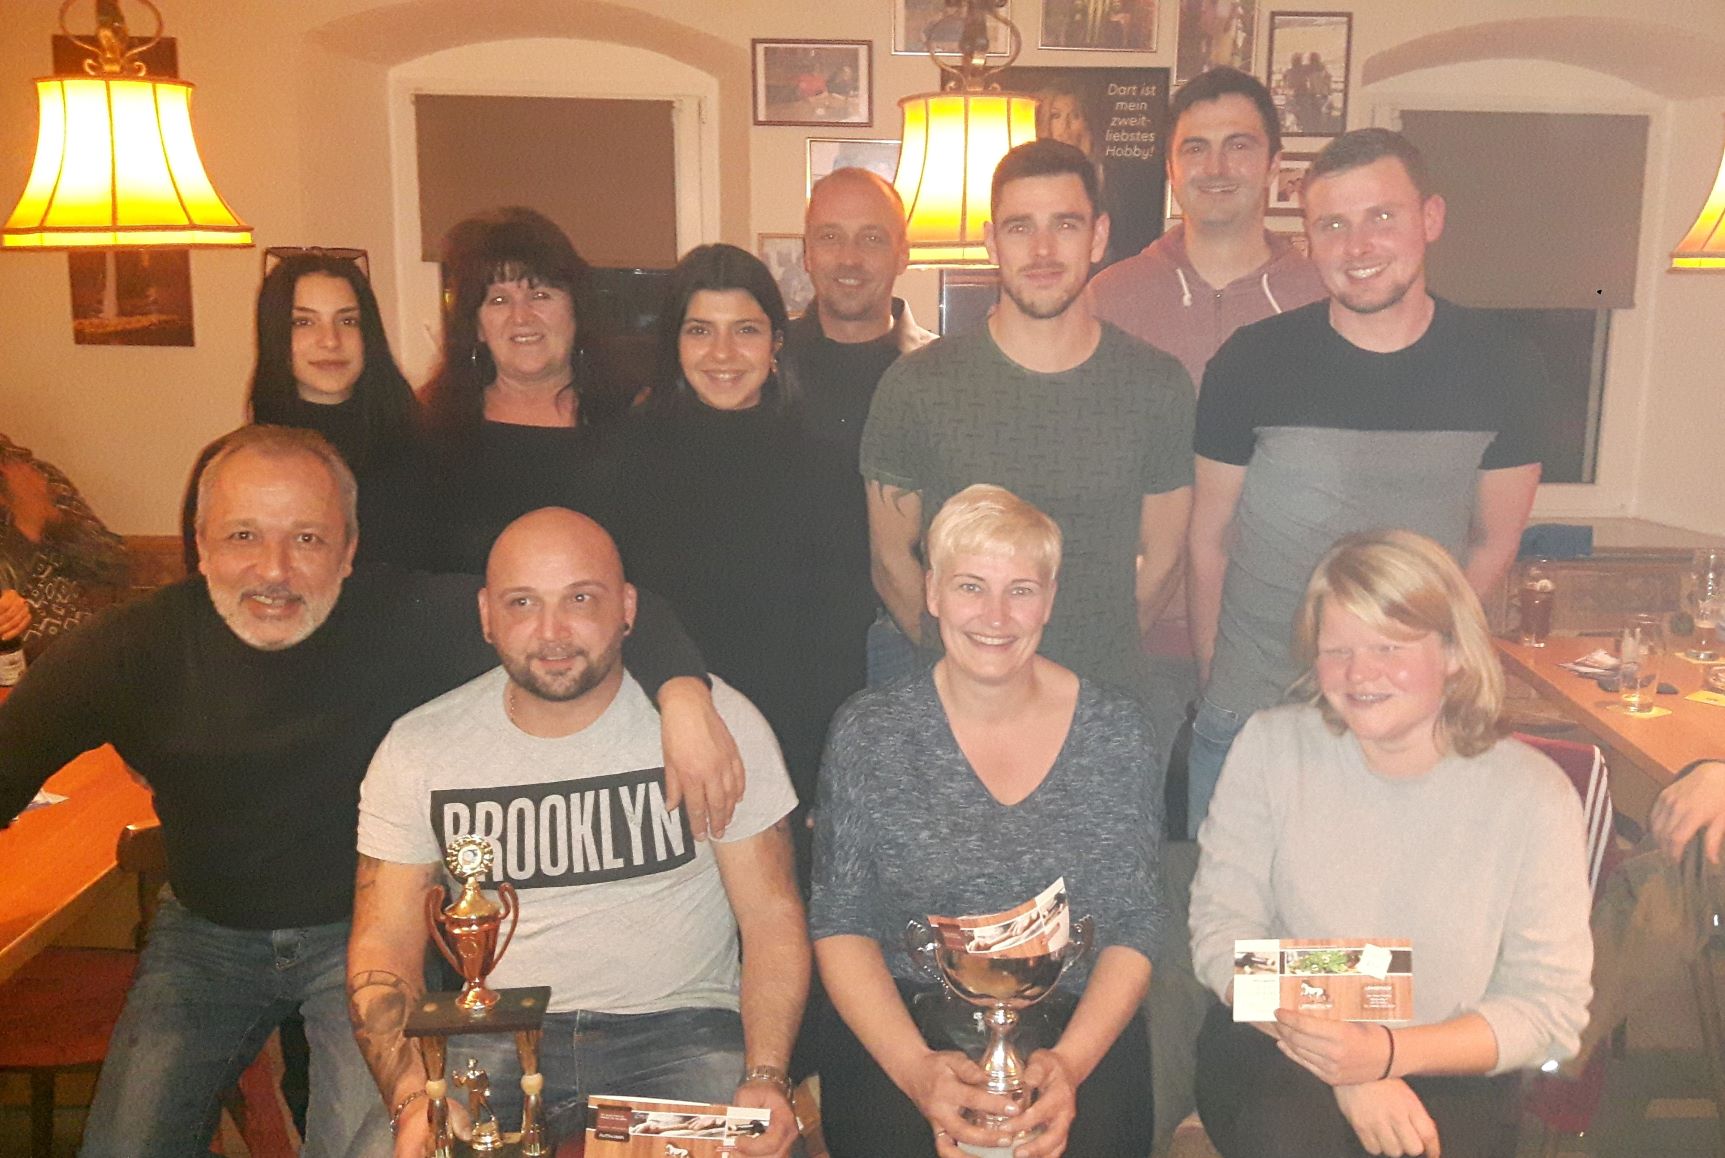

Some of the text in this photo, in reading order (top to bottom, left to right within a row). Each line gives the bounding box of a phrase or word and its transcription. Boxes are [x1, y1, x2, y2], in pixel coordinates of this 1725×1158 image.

[1108, 82, 1156, 96] Dart ist
[1115, 100, 1148, 111] mein
[1110, 114, 1151, 126] zweit-
[1105, 129, 1156, 142] liebstes
[1105, 144, 1155, 160] Hobby!
